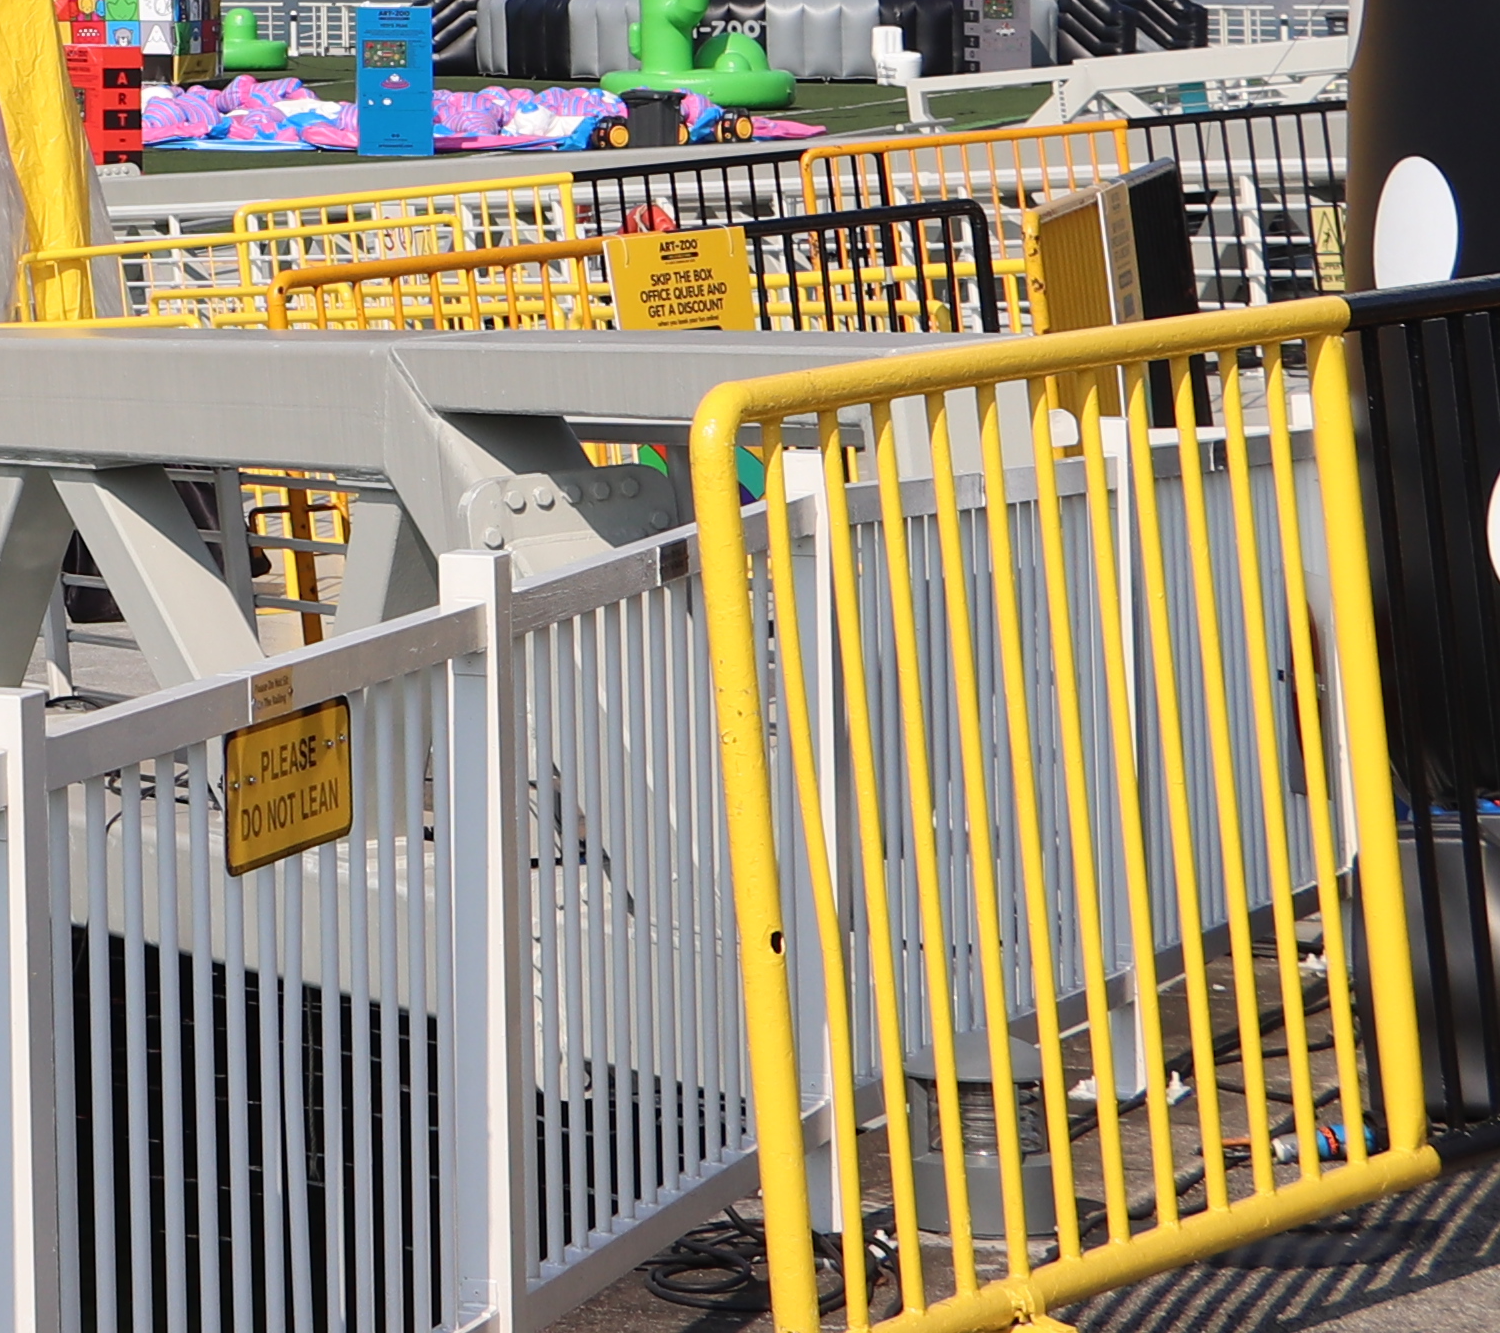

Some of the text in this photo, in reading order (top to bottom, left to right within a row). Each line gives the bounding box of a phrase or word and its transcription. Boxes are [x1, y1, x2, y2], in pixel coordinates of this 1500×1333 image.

[117, 71, 128, 164] ART-Z
[659, 238, 698, 253] ART-ZOO
[650, 268, 713, 286] SKIP THE BOX
[640, 282, 727, 304] OFFICE QUEUE AND
[648, 298, 724, 318] GET A DISCOUNT
[261, 735, 317, 784] PLEASE
[241, 777, 339, 841] DO NOT LEAN
